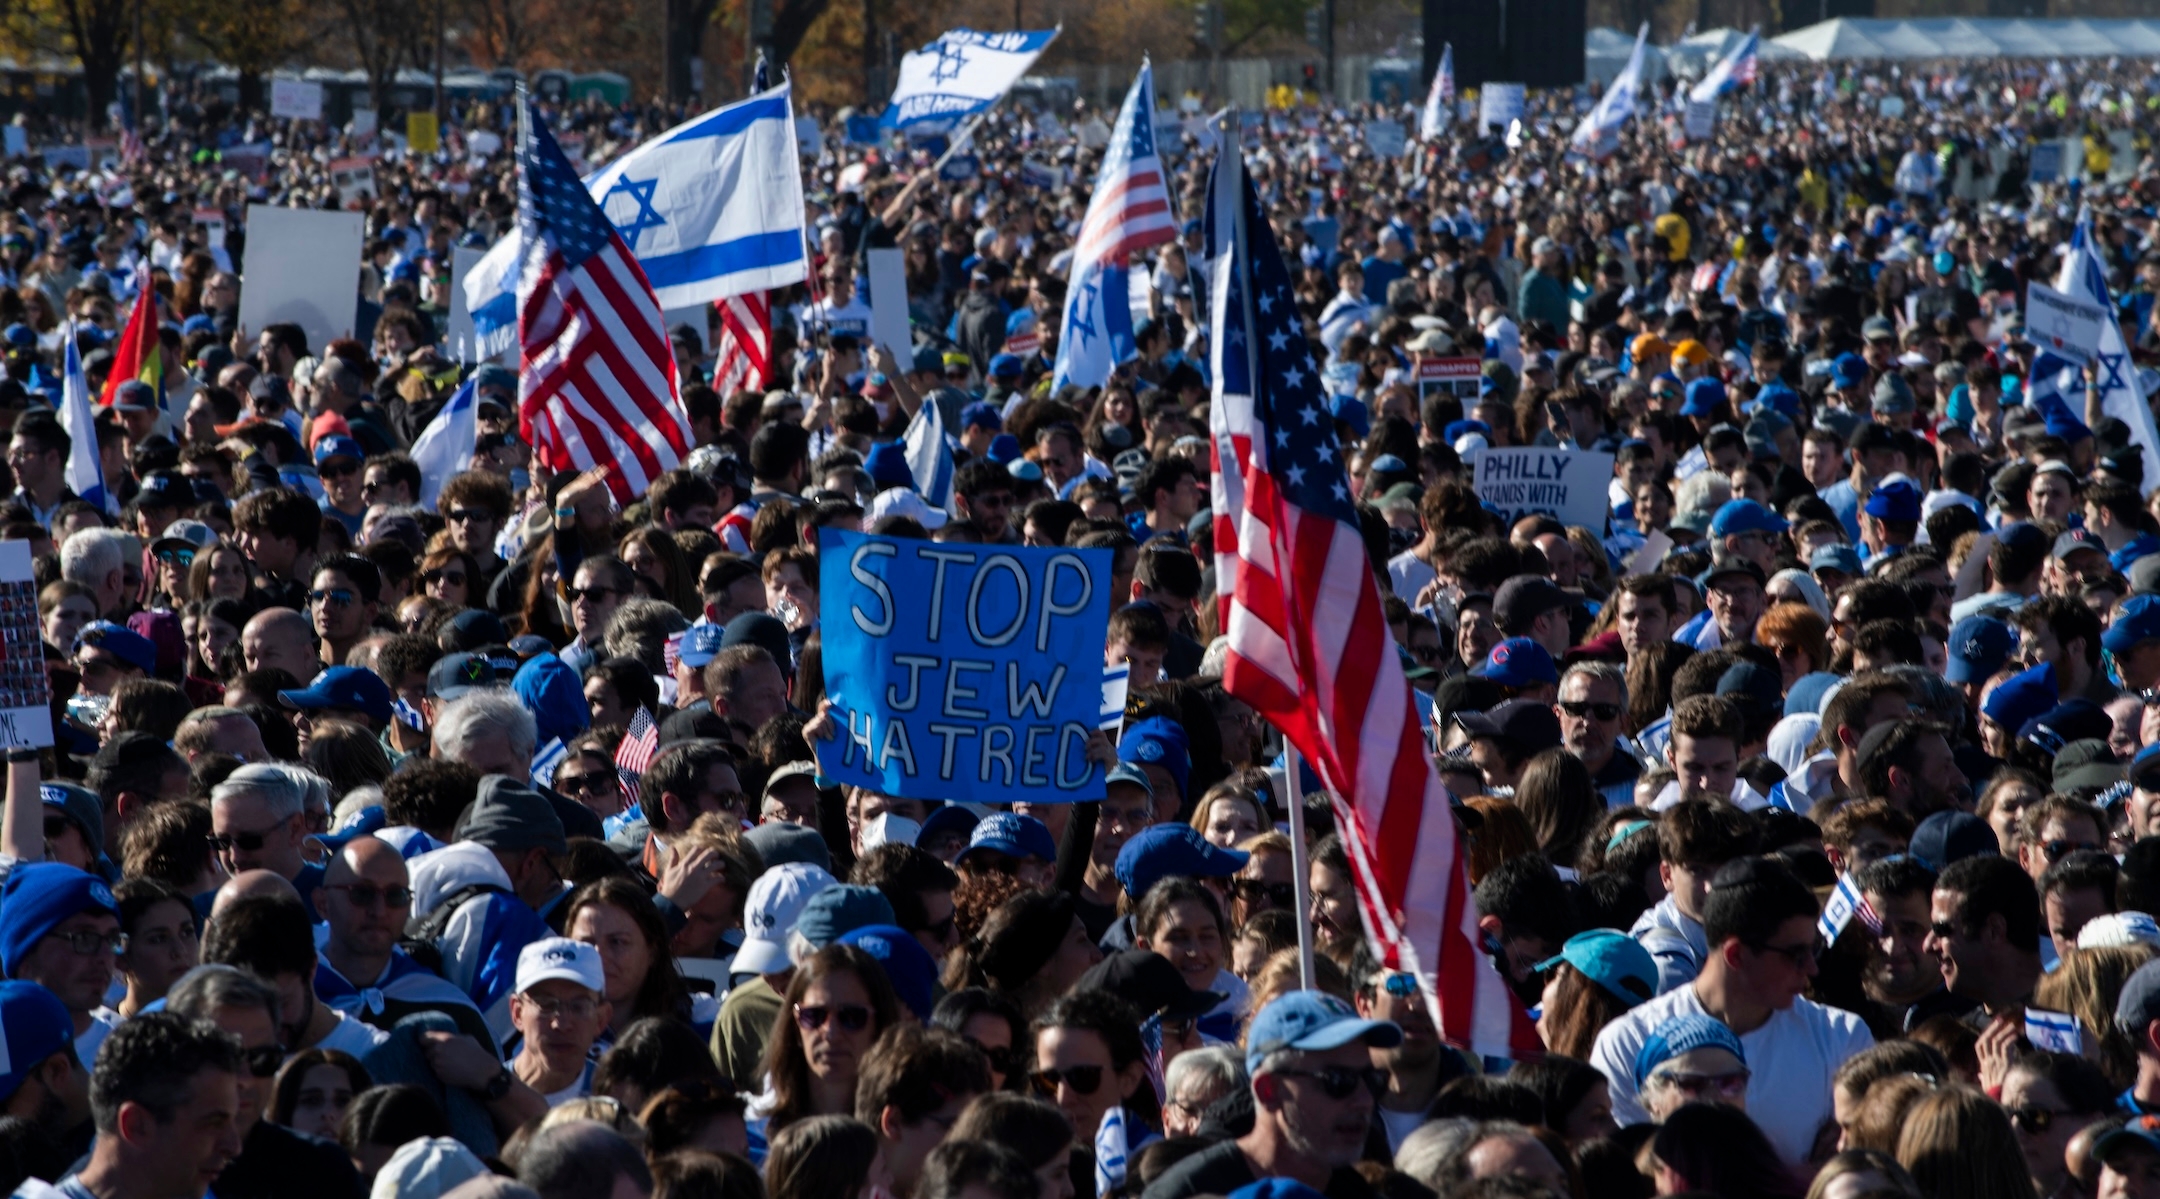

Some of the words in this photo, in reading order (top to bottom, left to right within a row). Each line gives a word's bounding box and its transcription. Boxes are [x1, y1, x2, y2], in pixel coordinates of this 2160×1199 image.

[1422, 363, 1479, 375] KIDNAPPED
[1483, 454, 1571, 481] PHILLY
[1481, 482, 1526, 505] STANDS
[1527, 484, 1567, 506] WITH
[849, 541, 1094, 653] STOP
[887, 655, 1067, 720] JEW
[0, 711, 29, 747] ME.
[844, 707, 1095, 790] HATRED
